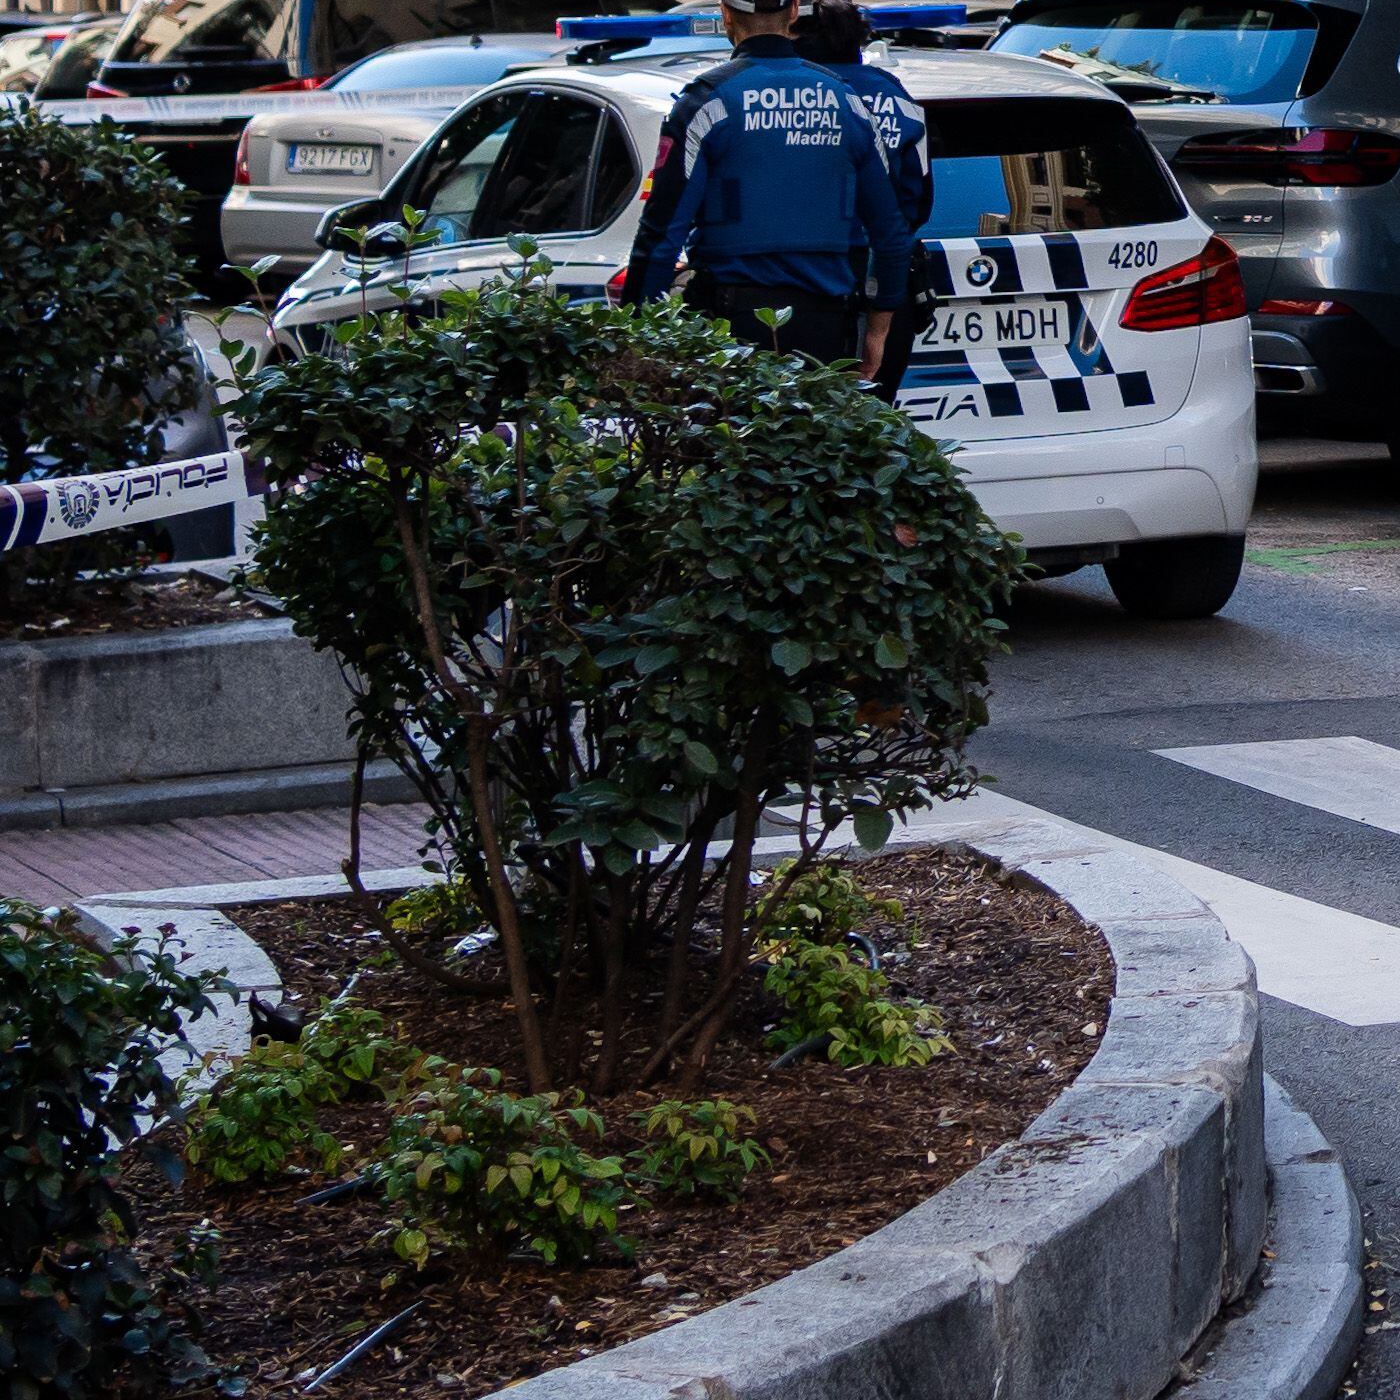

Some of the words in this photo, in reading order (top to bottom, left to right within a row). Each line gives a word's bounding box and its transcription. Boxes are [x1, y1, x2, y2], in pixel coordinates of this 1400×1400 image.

[743, 81, 840, 111] POLICÍA
[744, 110, 842, 132] MUNICIPAL
[785, 130, 842, 146] Madrid
[1108, 240, 1159, 270] 4280
[921, 311, 984, 346] 246
[995, 307, 1060, 341] MDH
